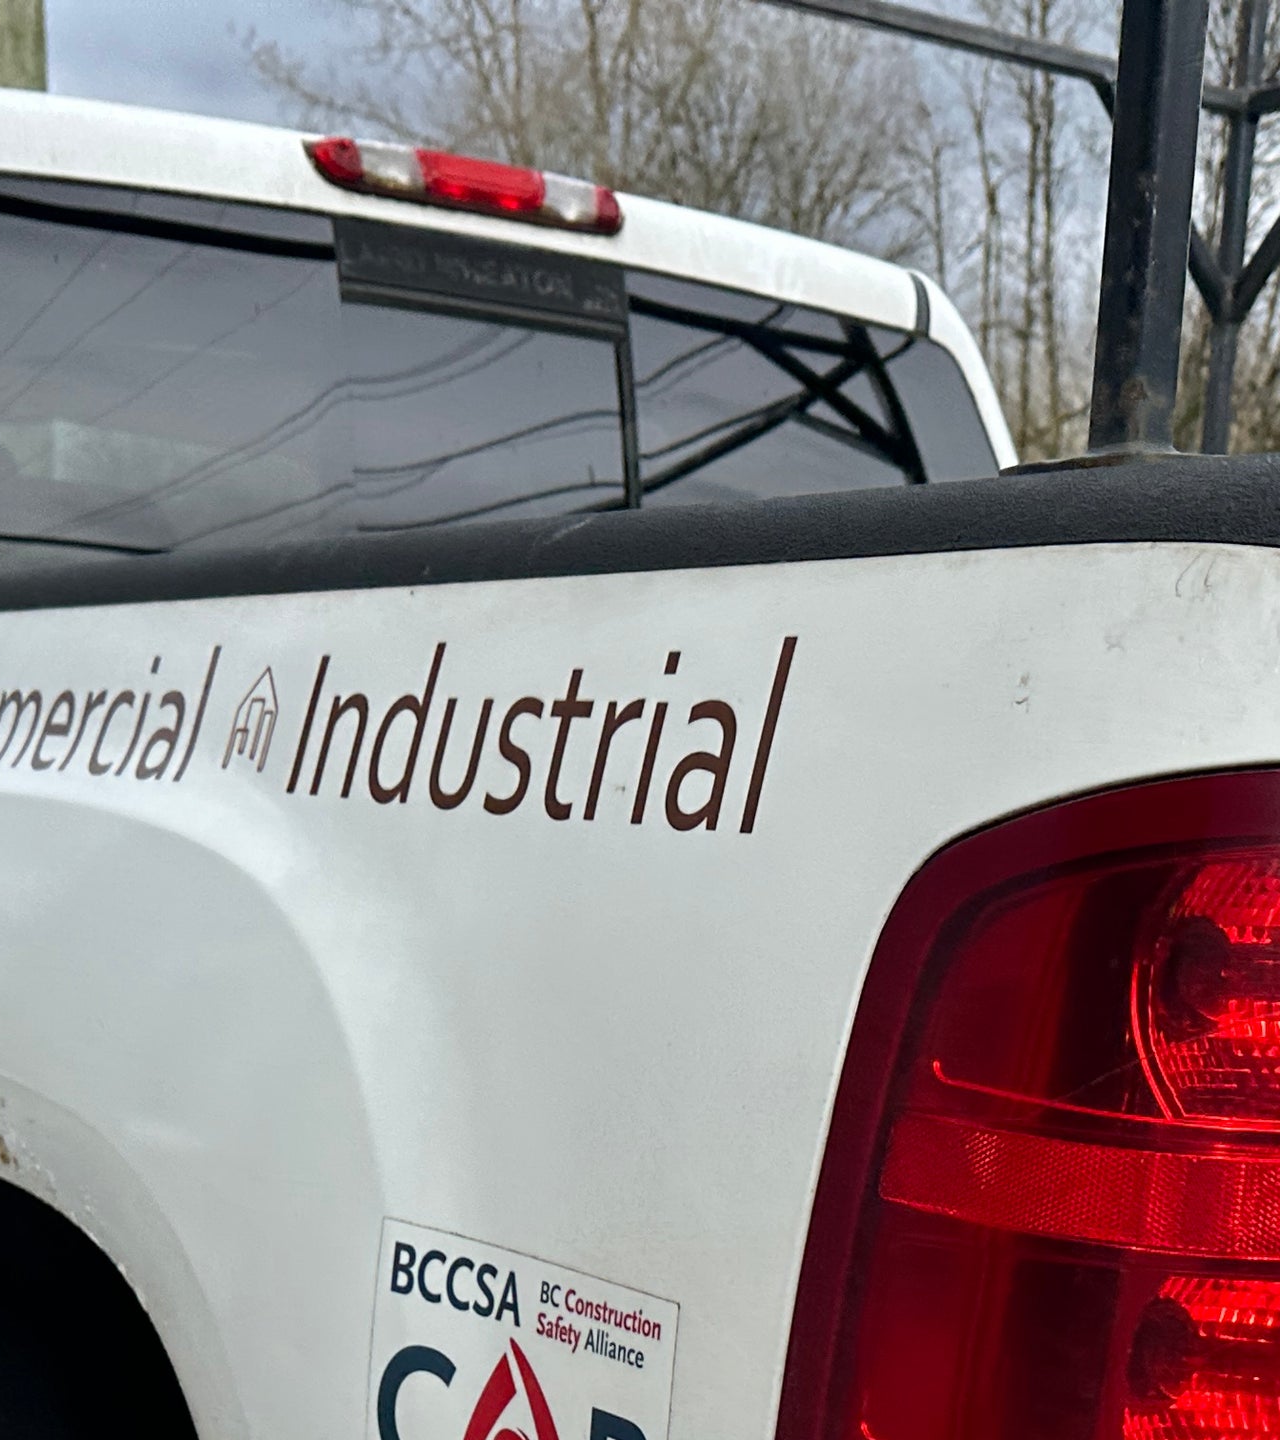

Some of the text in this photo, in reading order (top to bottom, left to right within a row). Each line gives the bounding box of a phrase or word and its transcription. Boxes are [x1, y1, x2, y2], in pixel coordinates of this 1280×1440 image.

[286, 636, 799, 834] Industrial
[390, 1241, 521, 1327] BCCSA
[540, 1281, 661, 1341] BC Construction
[536, 1312, 644, 1369] Safety Alliance
